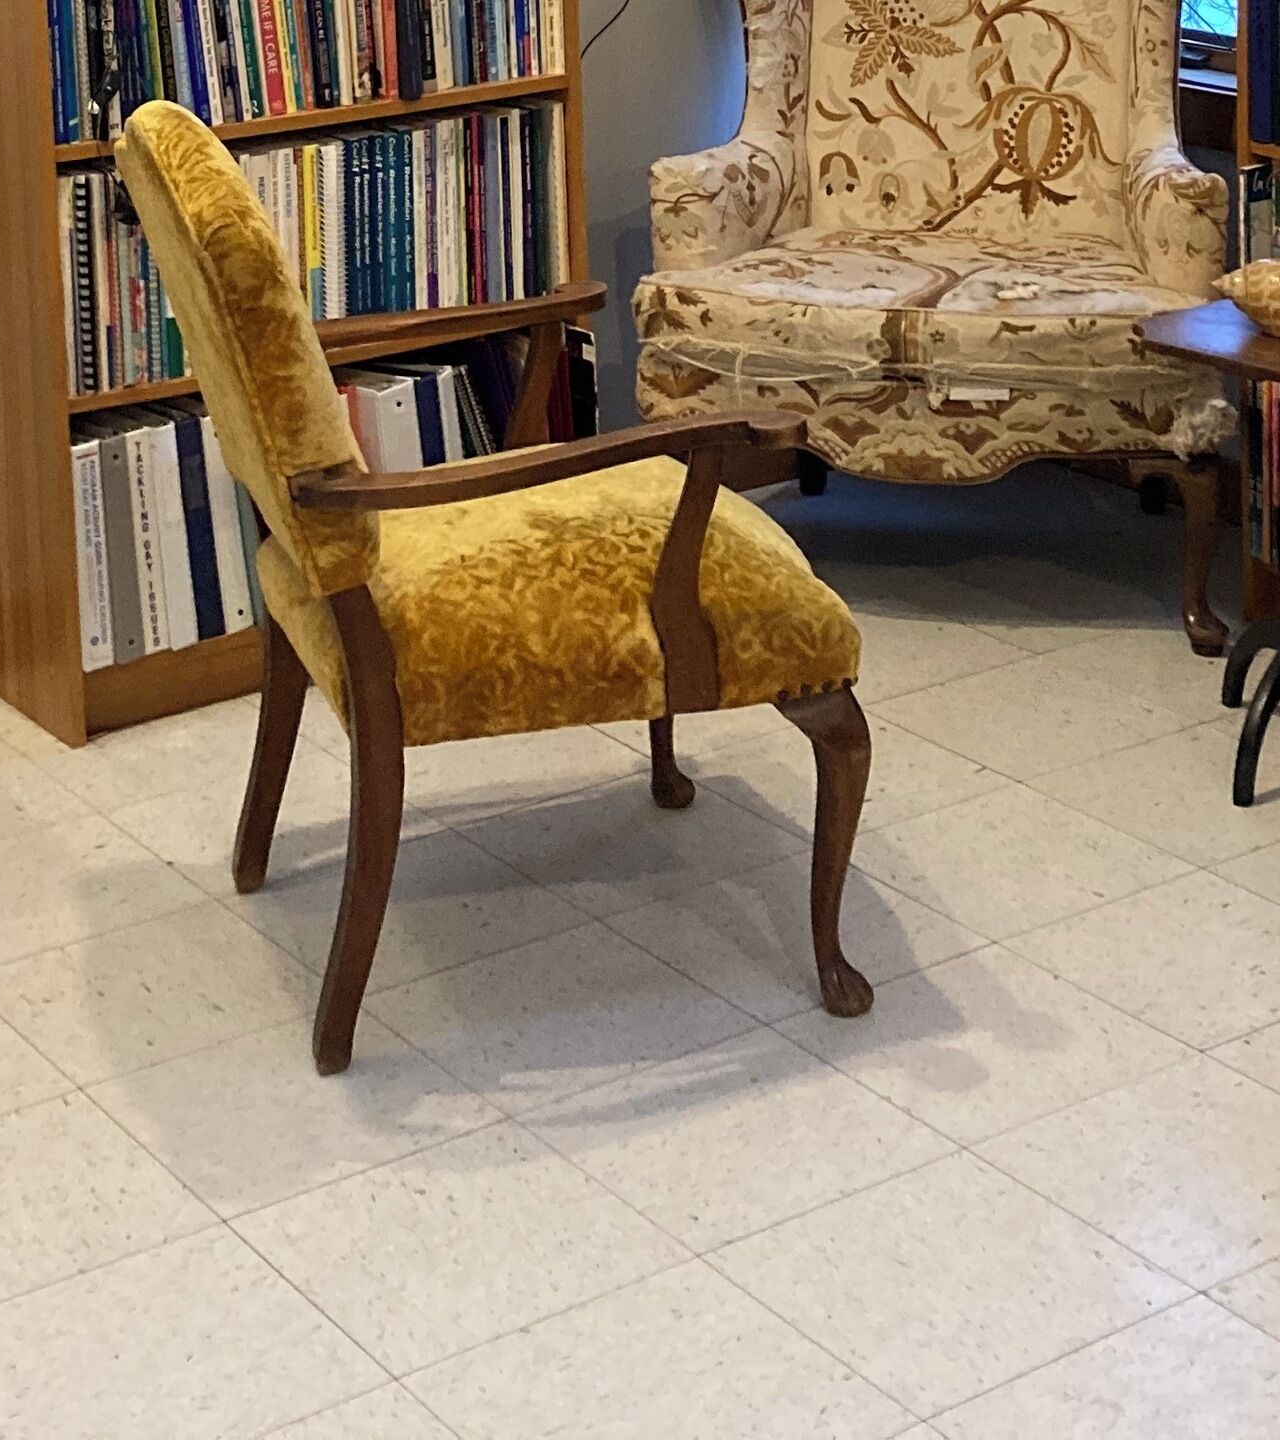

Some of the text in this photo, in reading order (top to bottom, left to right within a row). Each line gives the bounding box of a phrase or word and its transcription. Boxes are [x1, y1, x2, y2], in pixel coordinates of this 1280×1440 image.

[261, 20, 273, 32] IF
[263, 42, 279, 75] CARE
[402, 165, 412, 220] Resolution
[135, 441, 161, 647] TACKLING GAY ISSUES
